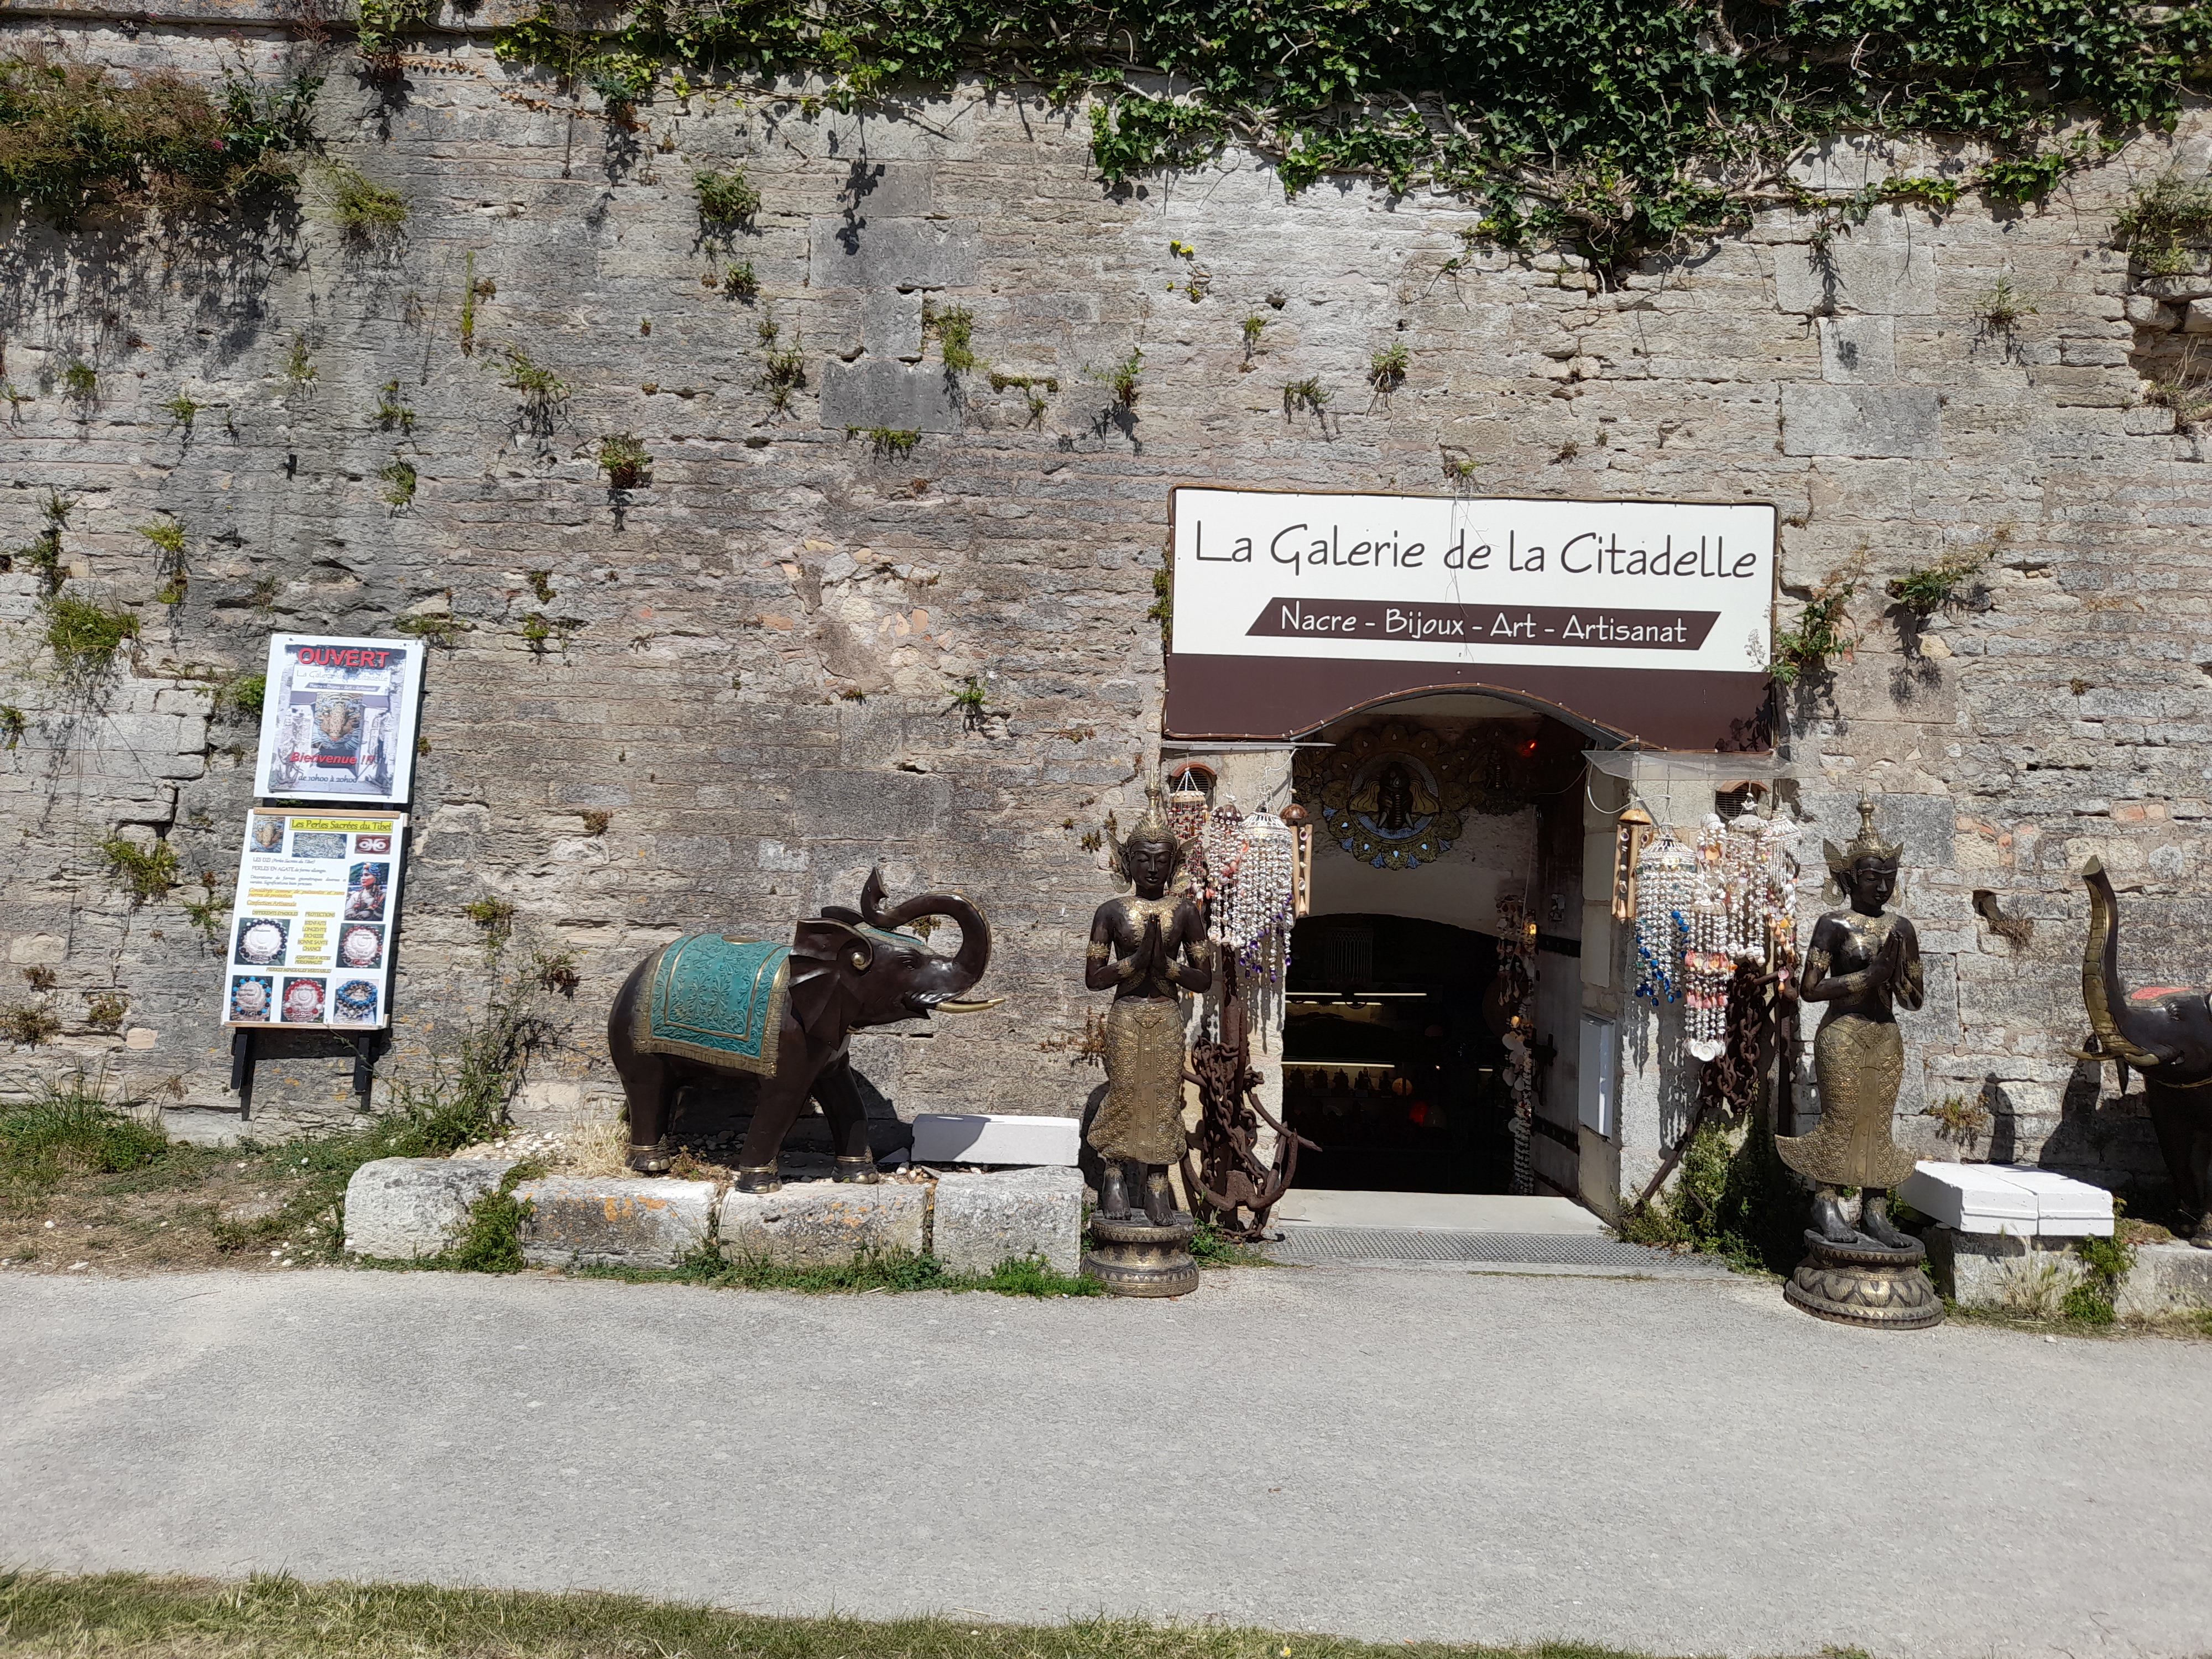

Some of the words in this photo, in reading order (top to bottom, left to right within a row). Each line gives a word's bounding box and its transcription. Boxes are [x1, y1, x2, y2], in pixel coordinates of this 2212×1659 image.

[1196, 520, 1252, 562] La
[1270, 523, 1425, 576] Galerie
[1443, 528, 1491, 570] de
[1509, 529, 1545, 572] la
[1561, 531, 1757, 578] Citadelle
[1281, 601, 1357, 632] Nacre
[1385, 608, 1464, 639] Bijoux
[1489, 612, 1537, 639] Art
[1562, 614, 1687, 643] Artisanat
[299, 647, 390, 668] OUVERT
[290, 752, 358, 765] Bienvenue
[308, 773, 328, 782] 10h00
[291, 819, 304, 828] Les
[306, 820, 328, 829] Perles
[330, 820, 358, 830] Sacrées
[359, 820, 371, 830] du
[372, 821, 392, 831] Tibet
